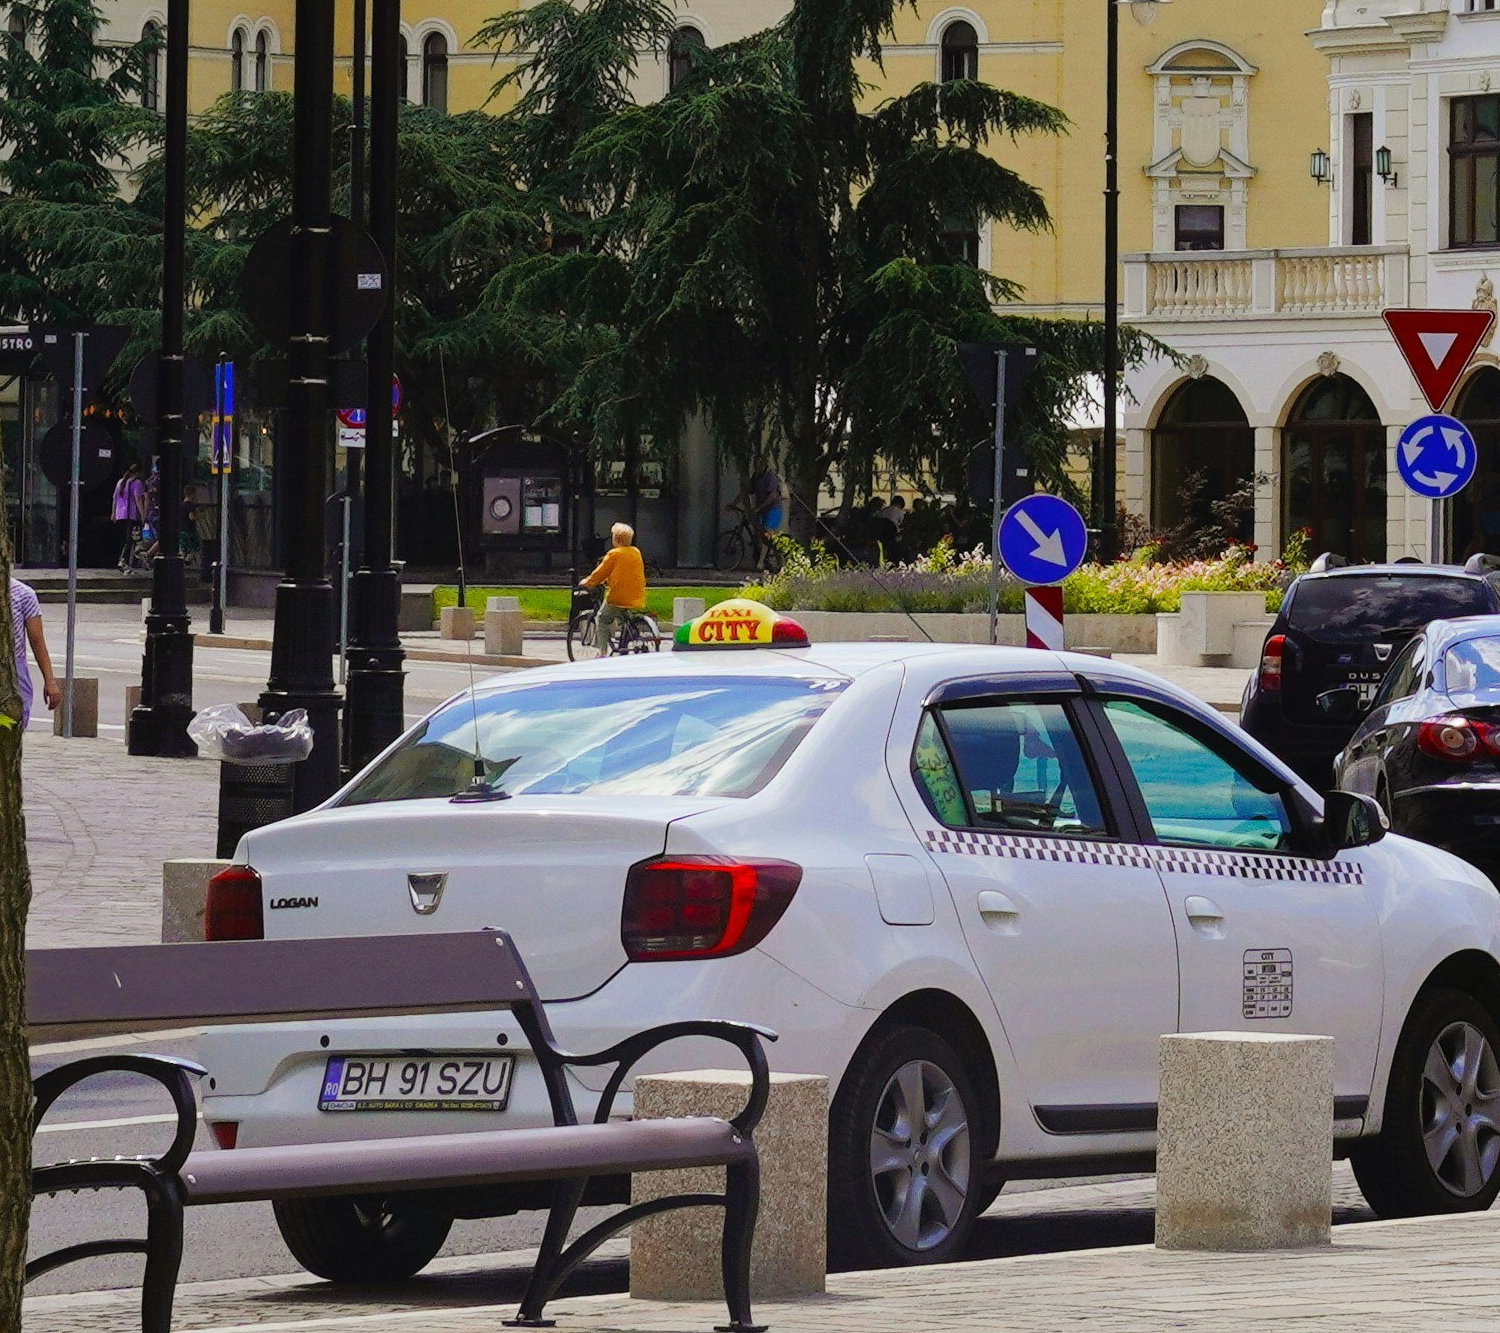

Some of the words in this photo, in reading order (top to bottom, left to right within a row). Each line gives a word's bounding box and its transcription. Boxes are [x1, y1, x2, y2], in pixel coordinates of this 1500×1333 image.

[709, 608, 753, 618] TAXI
[698, 619, 762, 642] CITY
[1348, 672, 1386, 680] DUS
[270, 896, 319, 910] LOGAN
[341, 1061, 390, 1097] BH
[398, 1061, 432, 1096] 91
[436, 1061, 508, 1096] SZU
[324, 1082, 338, 1097] RO
